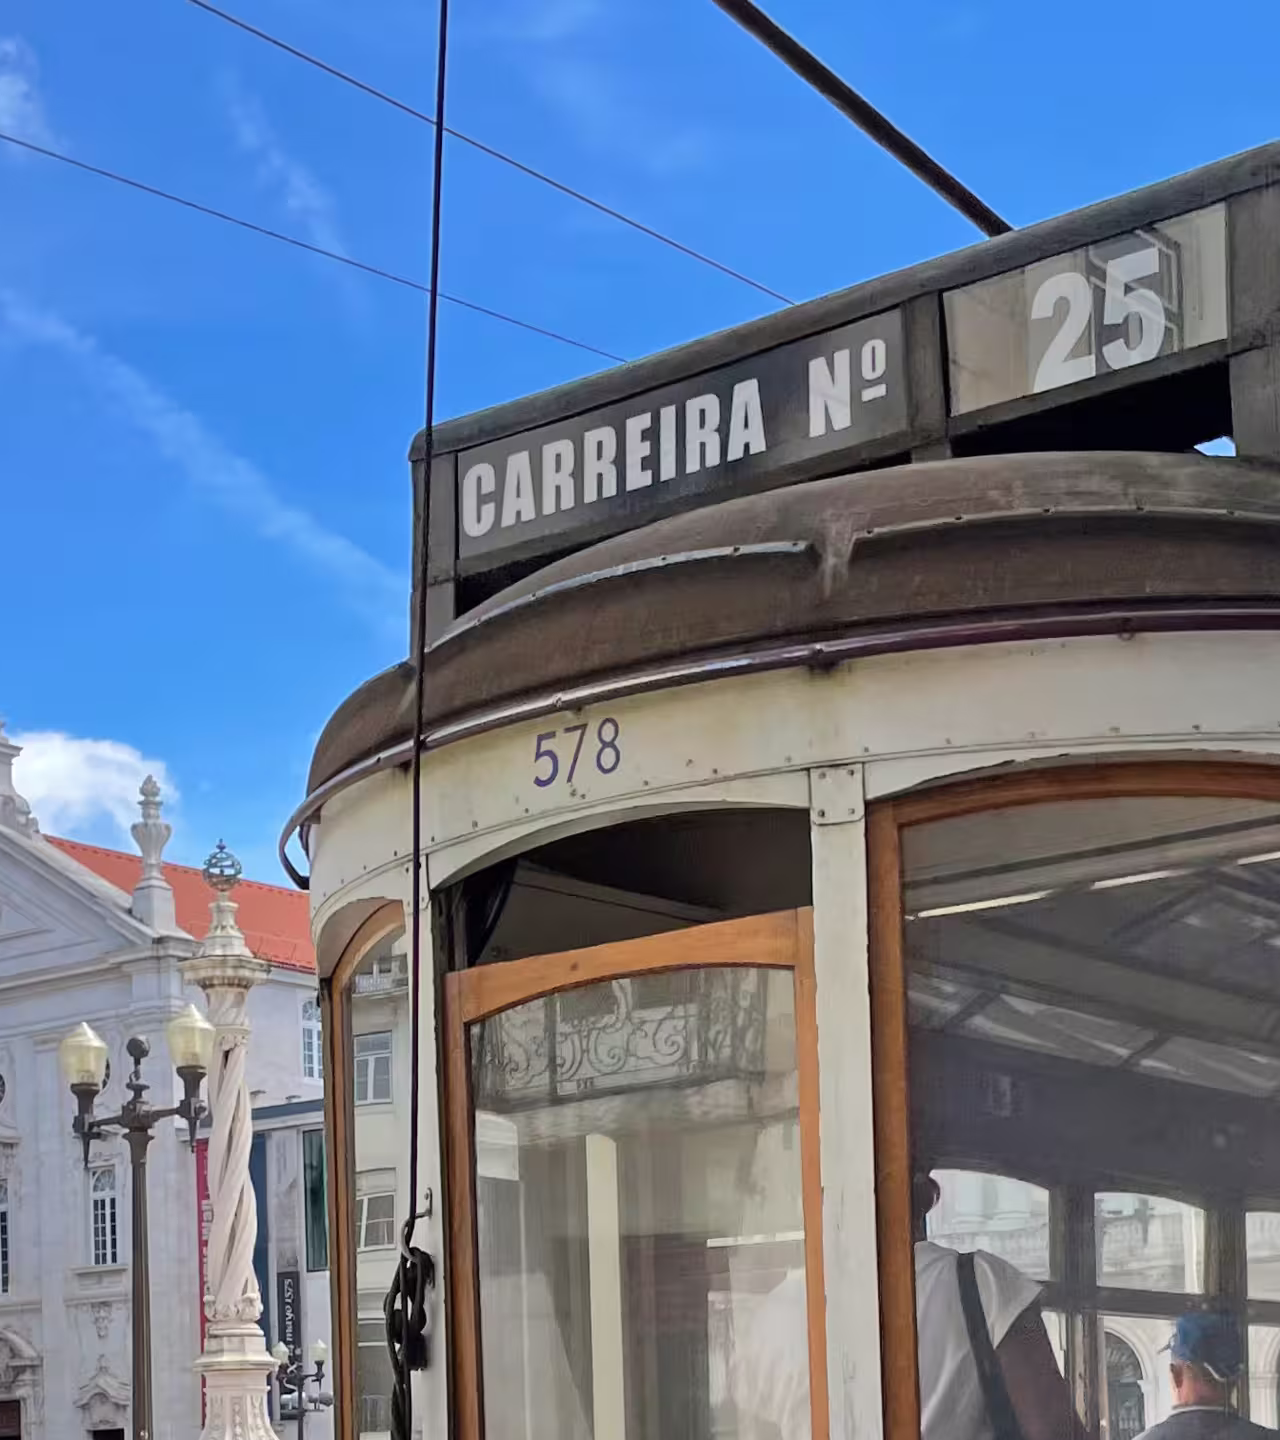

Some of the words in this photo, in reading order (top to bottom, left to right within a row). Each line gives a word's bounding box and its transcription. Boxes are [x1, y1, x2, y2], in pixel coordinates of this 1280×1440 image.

[463, 379, 767, 538] CARREIRA
[1030, 246, 1167, 395] 25
[533, 717, 622, 788] 578
